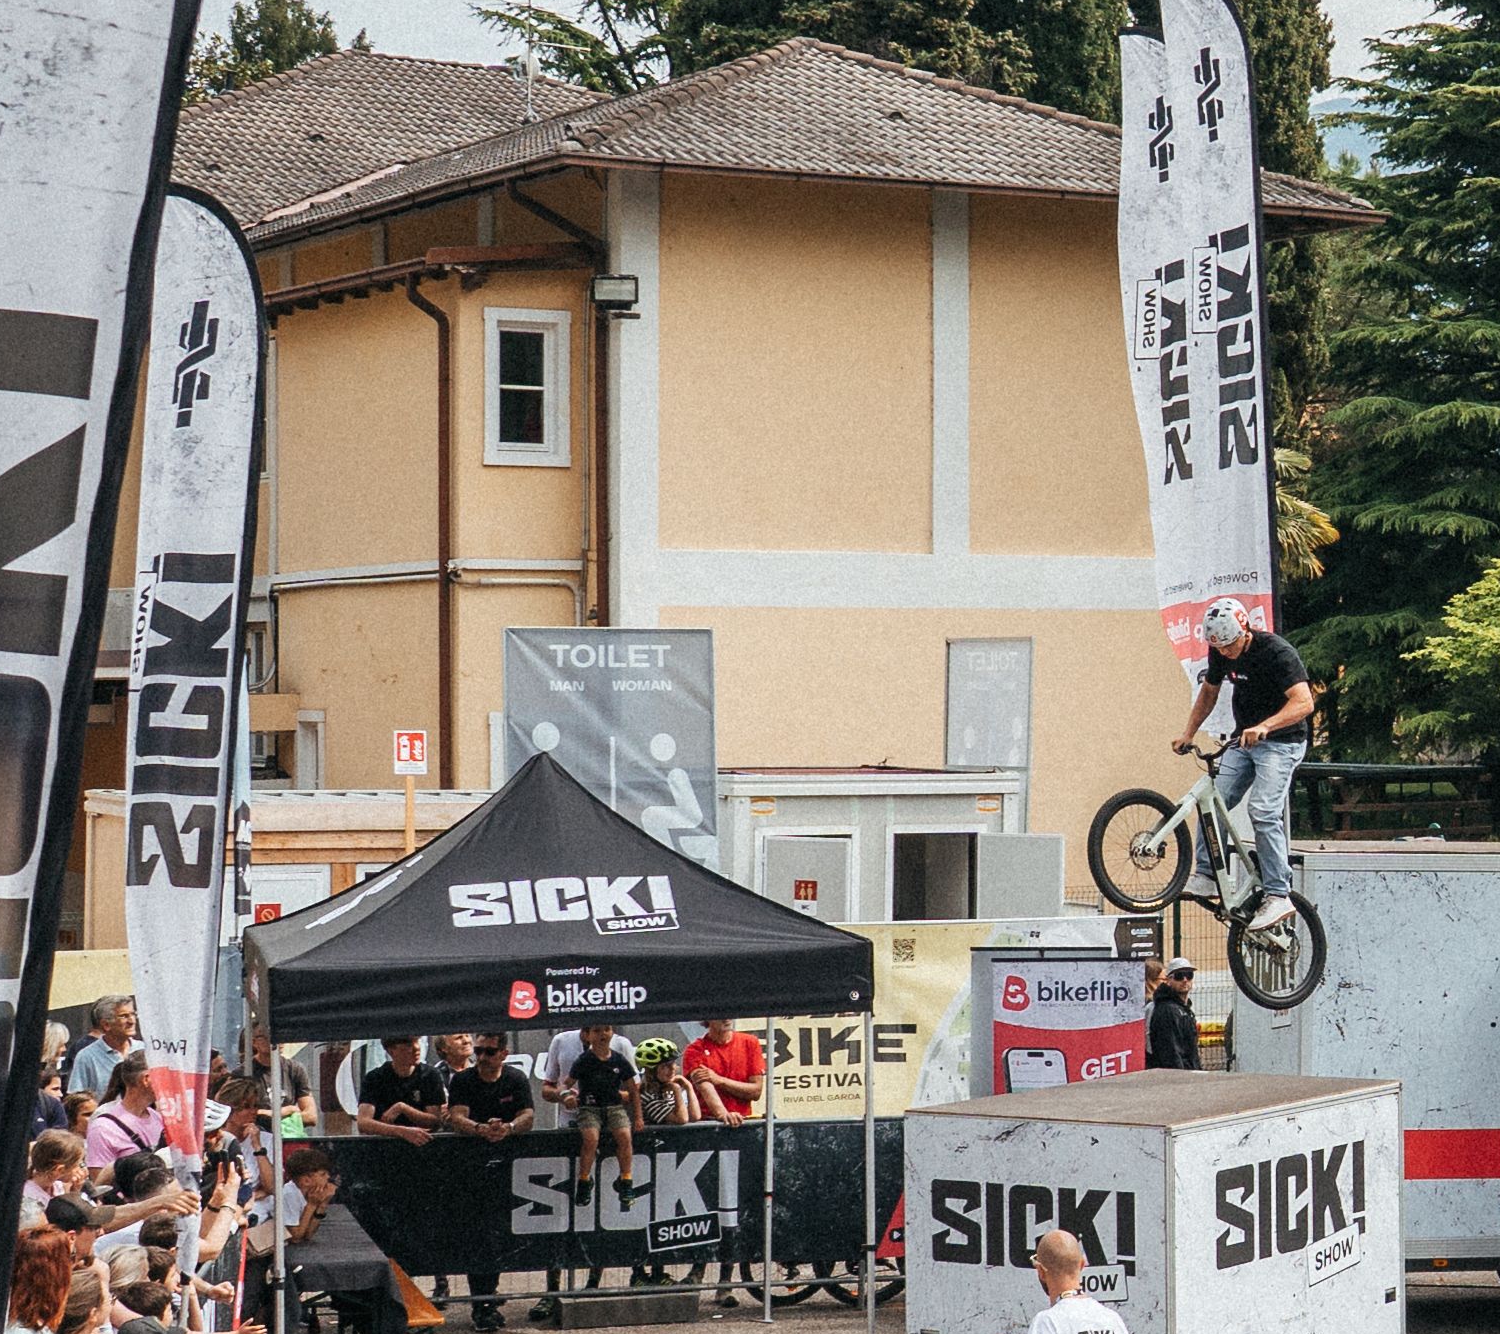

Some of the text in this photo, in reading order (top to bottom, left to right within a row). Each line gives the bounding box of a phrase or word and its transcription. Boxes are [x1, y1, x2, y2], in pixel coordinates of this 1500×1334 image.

[549, 643, 671, 668] TOILET
[549, 680, 672, 692] MAN WOMAN
[449, 875, 678, 928] SICK!
[607, 915, 667, 930] SHOW
[545, 967, 585, 976] Powered
[546, 980, 647, 1009] bikeflip
[1037, 980, 1129, 1007] bikeflip
[1080, 1050, 1133, 1080] GET
[772, 1071, 863, 1090] FESTIVA
[783, 1092, 861, 1104] RIVA DEL GARDA
[511, 1149, 740, 1234] SICK!
[1216, 1140, 1366, 1270] SICK!
[657, 1219, 712, 1242] SHOW
[931, 1178, 1136, 1277] SICK!
[1314, 1236, 1354, 1272] SHOW
[1077, 1272, 1119, 1293] HOW
